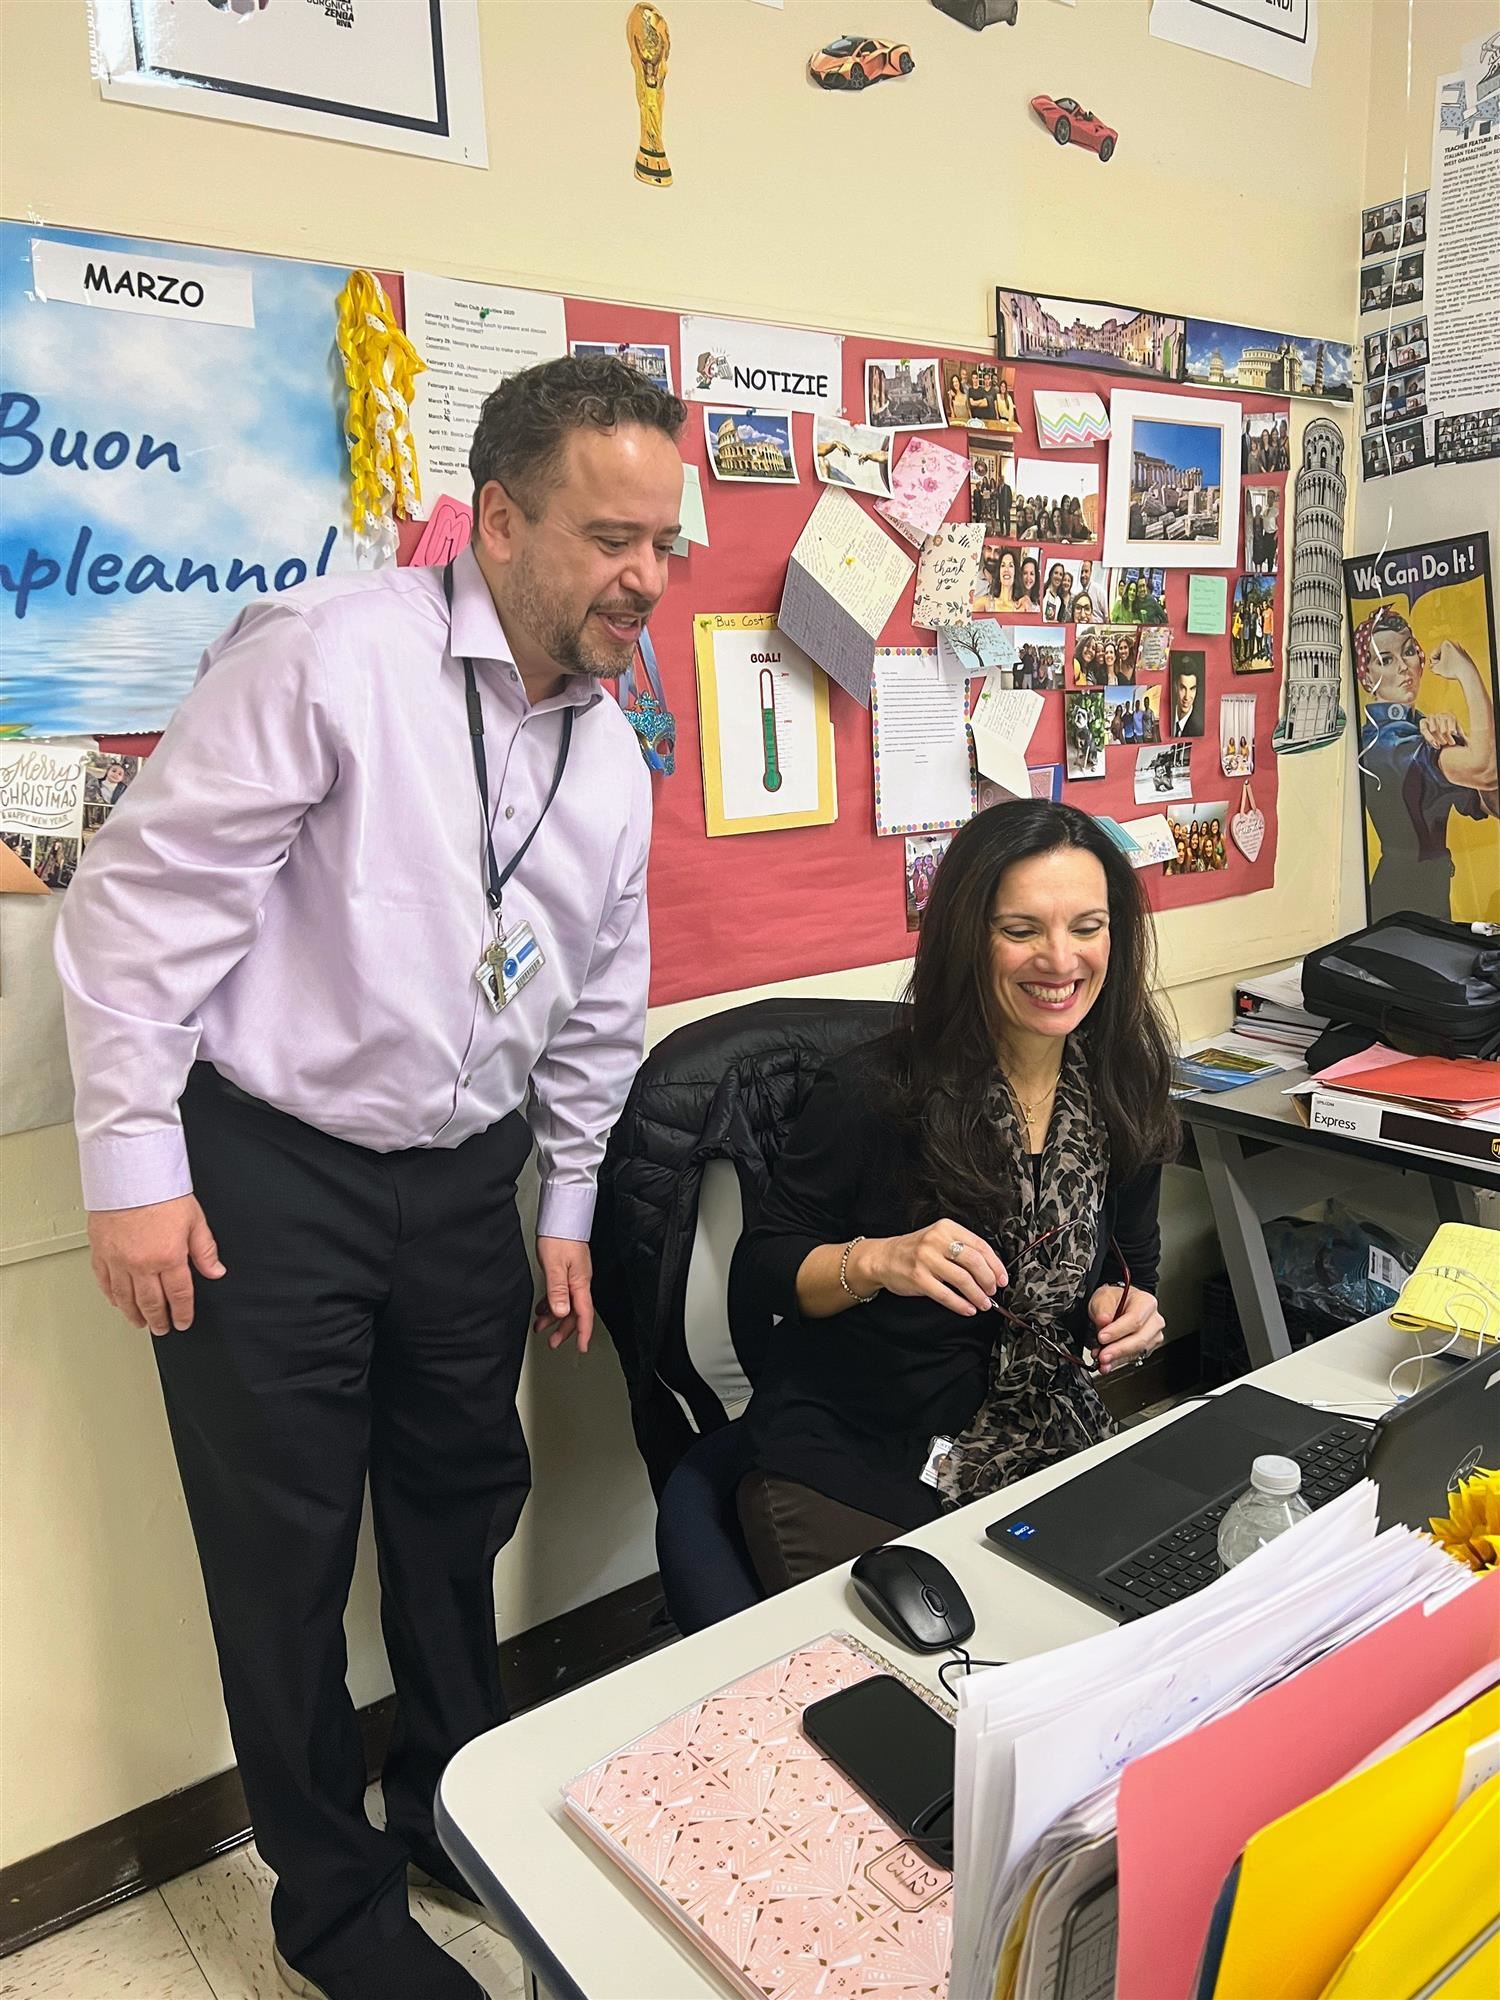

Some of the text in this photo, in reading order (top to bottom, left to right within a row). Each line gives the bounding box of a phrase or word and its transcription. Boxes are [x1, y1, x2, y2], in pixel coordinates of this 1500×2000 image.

[1444, 142, 1467, 153] TEACHER
[1444, 145, 1486, 160] ITALIAN TEACHER
[1458, 154, 1478, 163] ORANGE
[83, 262, 205, 308] MARZO
[425, 312, 442, 320] January
[426, 358, 446, 367] February
[428, 382, 448, 391] February
[734, 366, 828, 398] NOTIZIE
[0, 392, 181, 476] Buon
[0, 525, 338, 619] pleanno!
[933, 558, 966, 576] thank
[1353, 546, 1474, 592] We Can Do It!
[936, 578, 959, 591] you
[714, 615, 736, 627] Bus
[742, 614, 764, 626] Cost
[750, 652, 781, 663] GOAL!
[0, 751, 80, 791] Merry
[1, 782, 77, 808] CHRISTMAS
[8, 811, 31, 821] HAPPY
[32, 815, 48, 825] NEW
[49, 814, 70, 825] YEAR
[1314, 1112, 1356, 1130] Express
